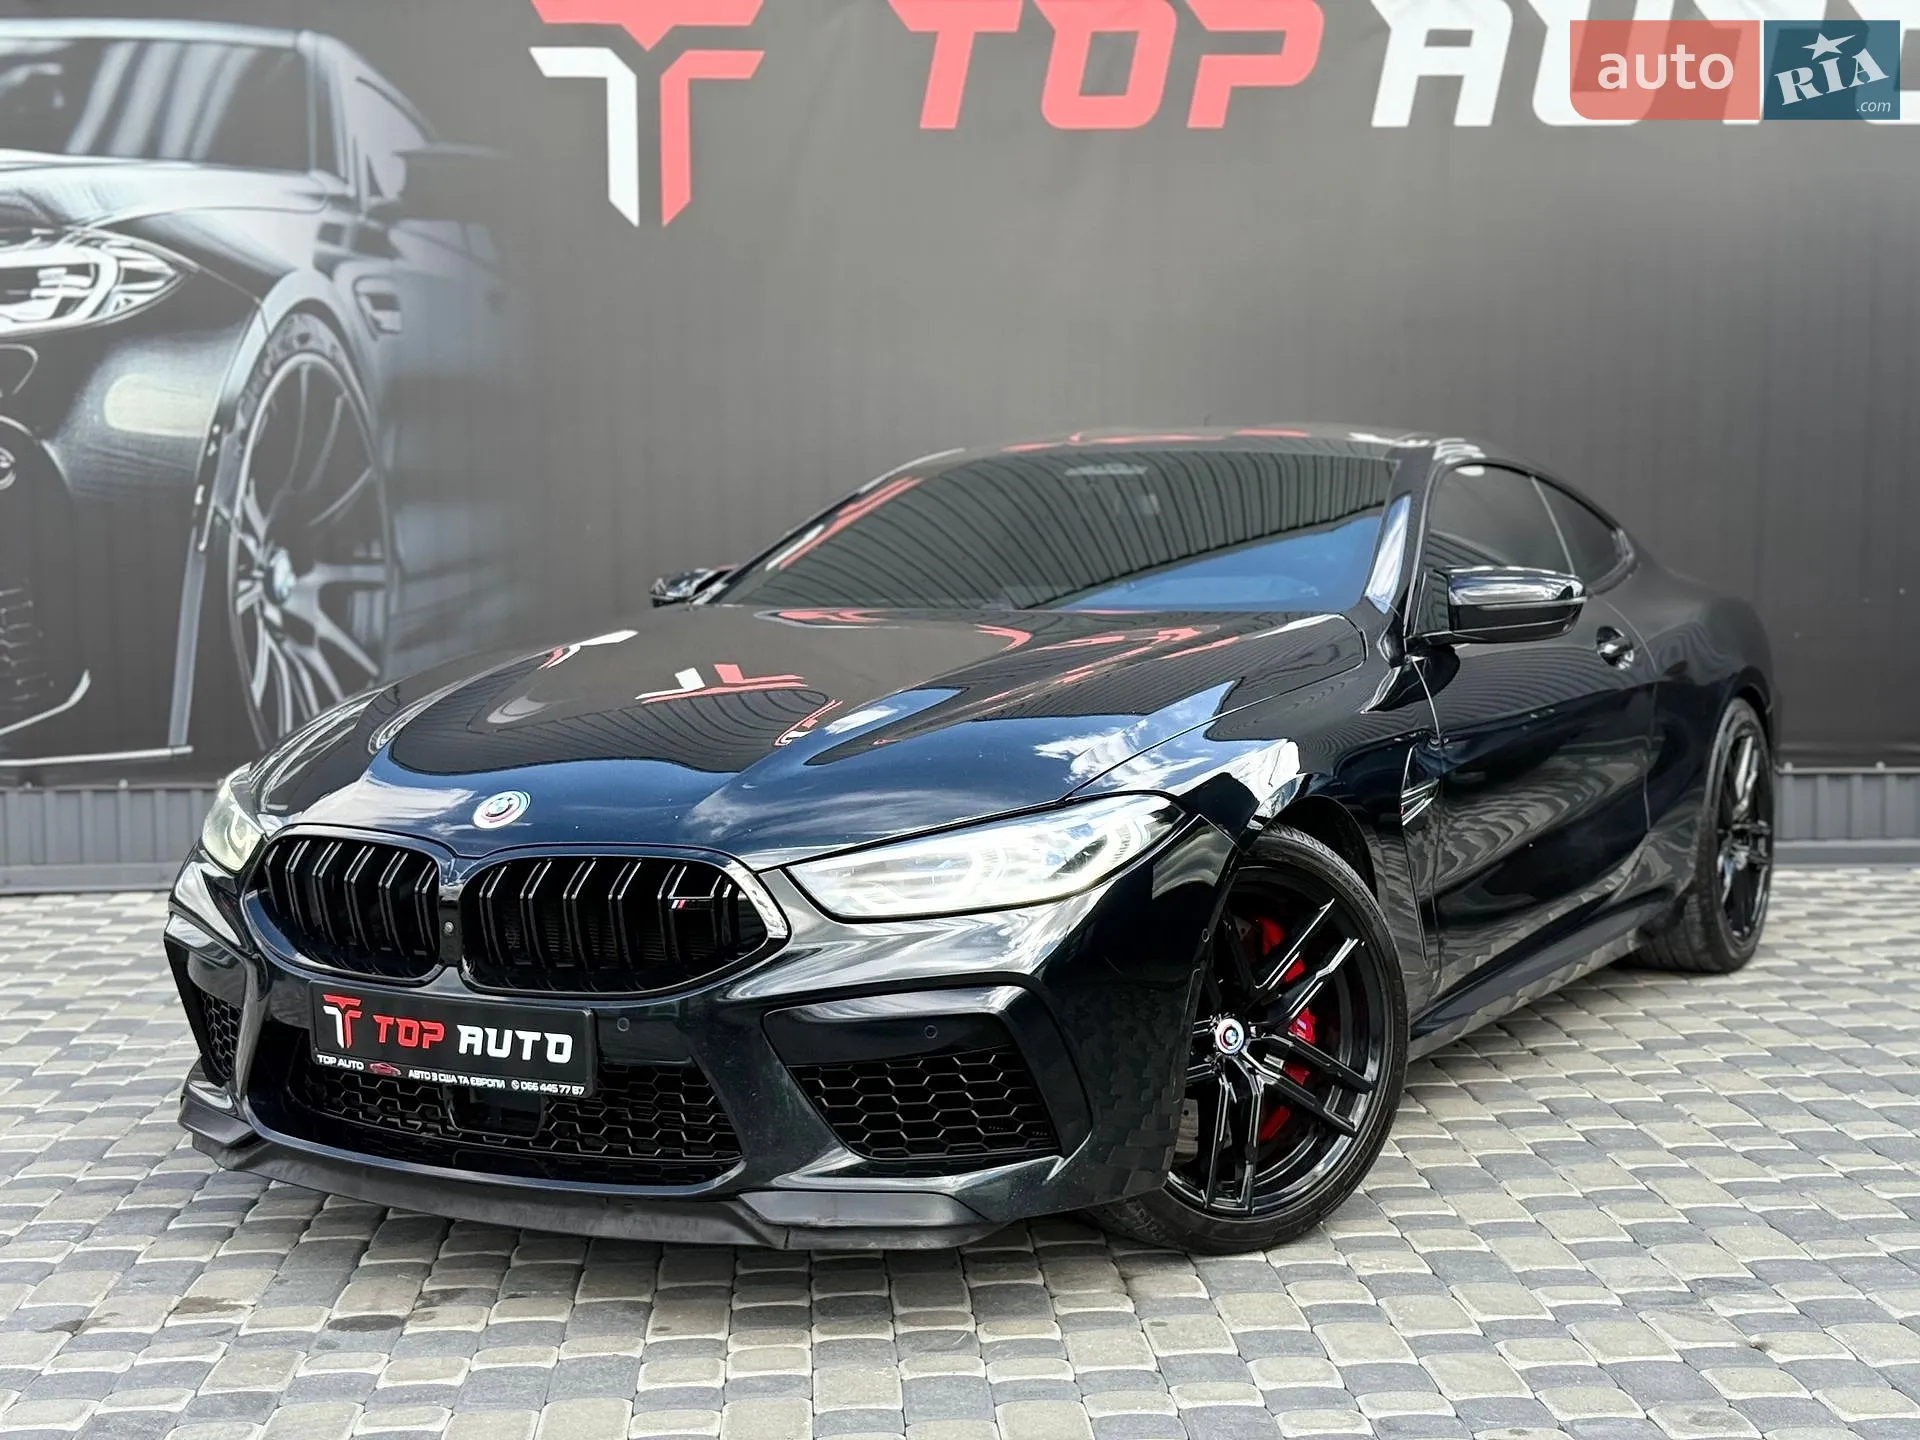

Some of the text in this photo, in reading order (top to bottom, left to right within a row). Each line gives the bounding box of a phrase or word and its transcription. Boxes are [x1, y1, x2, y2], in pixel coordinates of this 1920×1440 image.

[888, 0, 1324, 129] TOP
[373, 1014, 574, 1064] TOP AUTO
[316, 1054, 365, 1071] TOP AUTO
[558, 1084, 571, 1095] 77
